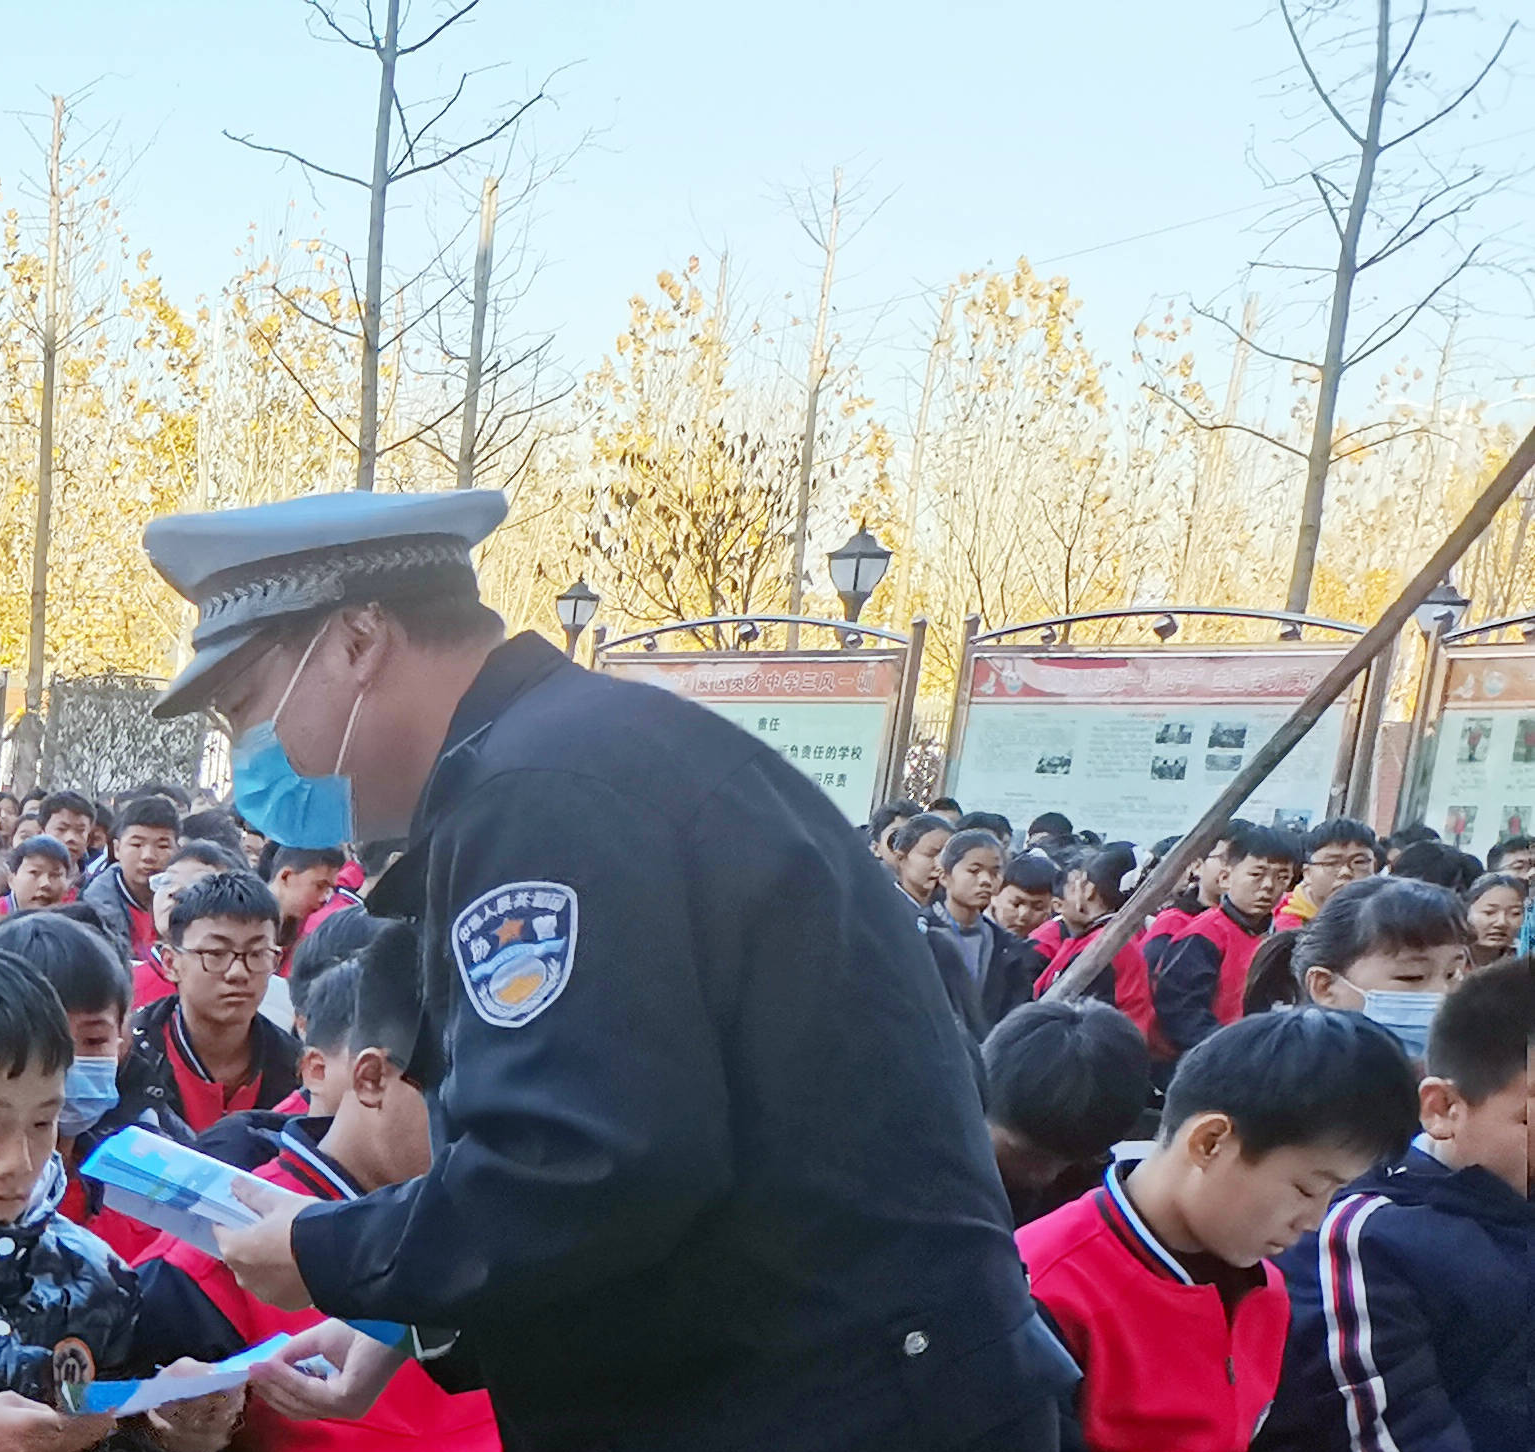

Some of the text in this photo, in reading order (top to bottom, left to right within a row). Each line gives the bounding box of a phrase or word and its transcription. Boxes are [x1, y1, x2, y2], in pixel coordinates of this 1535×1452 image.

[681, 670, 876, 693] 区英才中学三风一训
